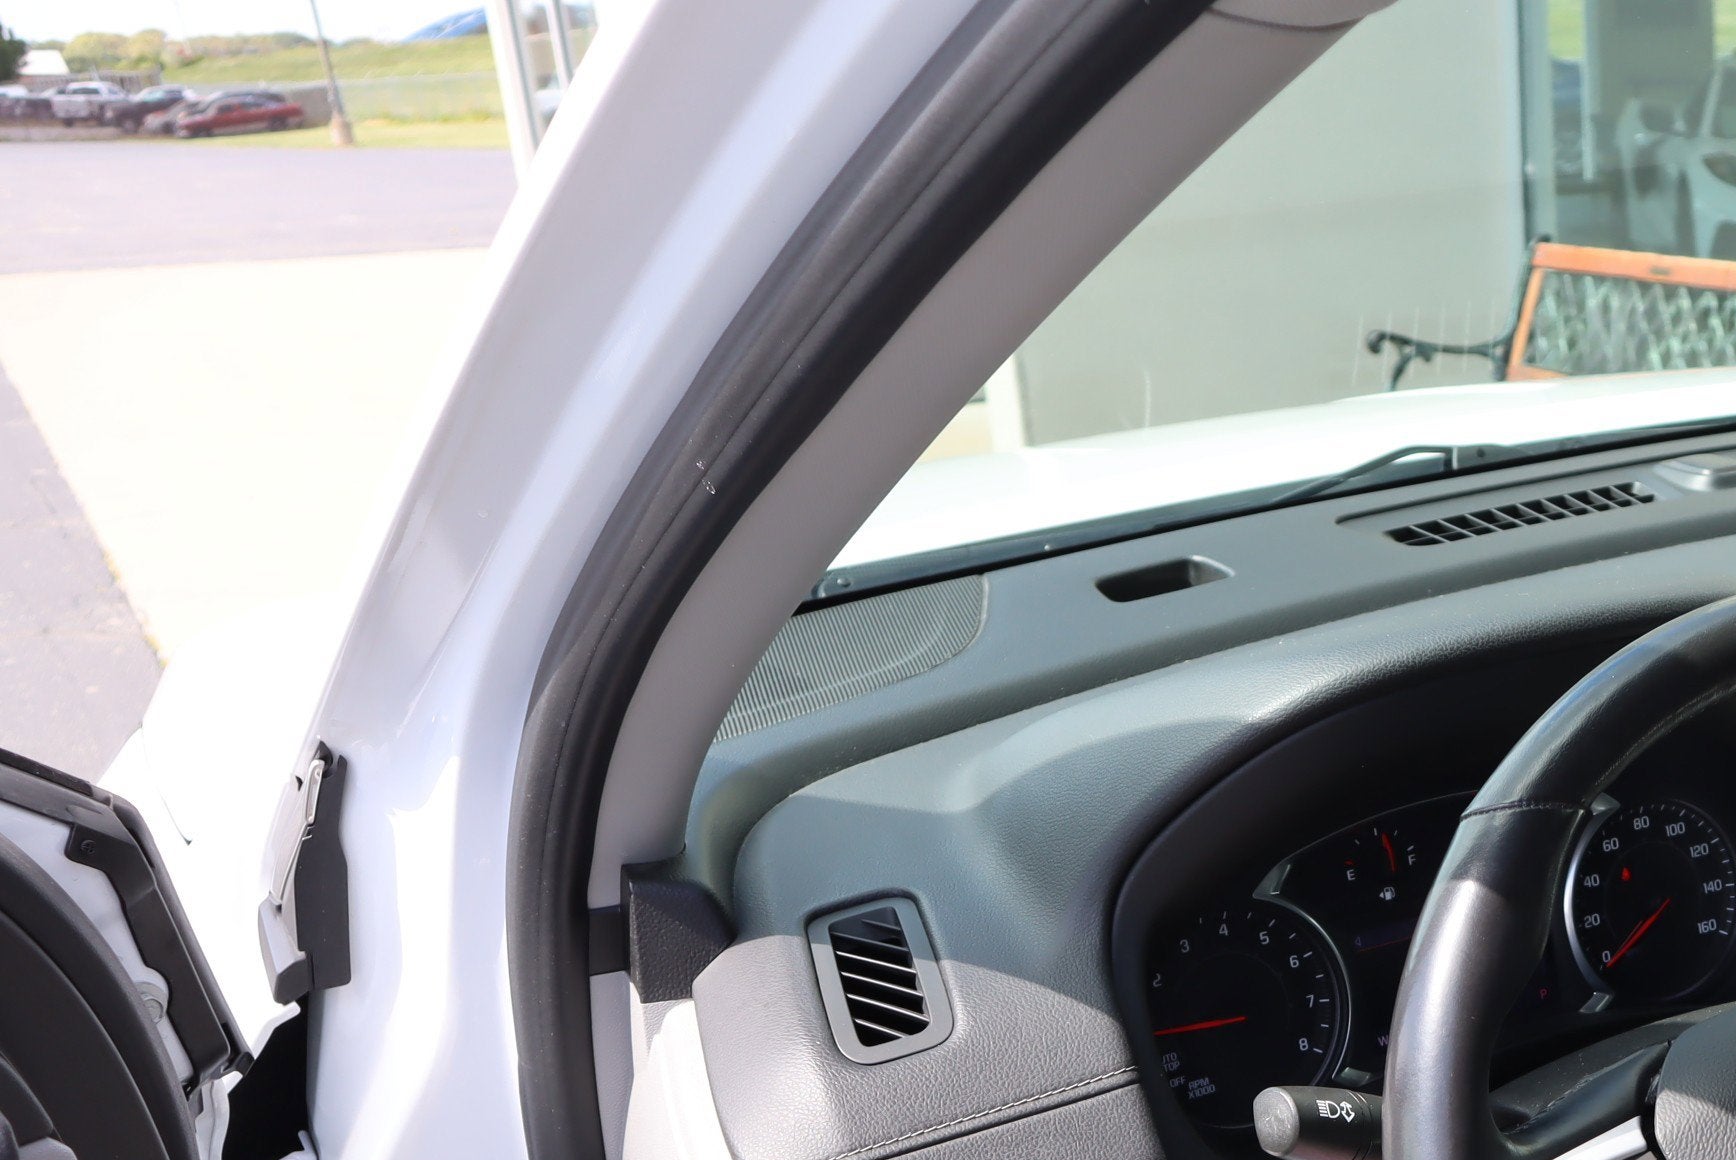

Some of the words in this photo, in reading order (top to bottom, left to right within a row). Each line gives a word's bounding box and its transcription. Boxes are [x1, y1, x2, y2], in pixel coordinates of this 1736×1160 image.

[1633, 816, 1650, 830] 80
[1665, 822, 1686, 837] 100
[1602, 837, 1619, 852] 60
[1689, 843, 1709, 858] 120
[1408, 854, 1417, 865] F
[1346, 869, 1356, 881] E
[1584, 874, 1600, 887] 40
[1702, 879, 1722, 894] 140
[1584, 913, 1600, 928] 20
[1697, 918, 1717, 934] 160
[1218, 924, 1229, 936] 4
[1259, 931, 1270, 945] 5
[1179, 939, 1190, 953] 3
[1289, 955, 1299, 968] 6
[1540, 988, 1547, 999] P
[1306, 994, 1315, 1008] 7
[1298, 1038, 1308, 1051] 8
[1169, 1076, 1186, 1088] OFF
[1189, 1077, 1210, 1090] RPM
